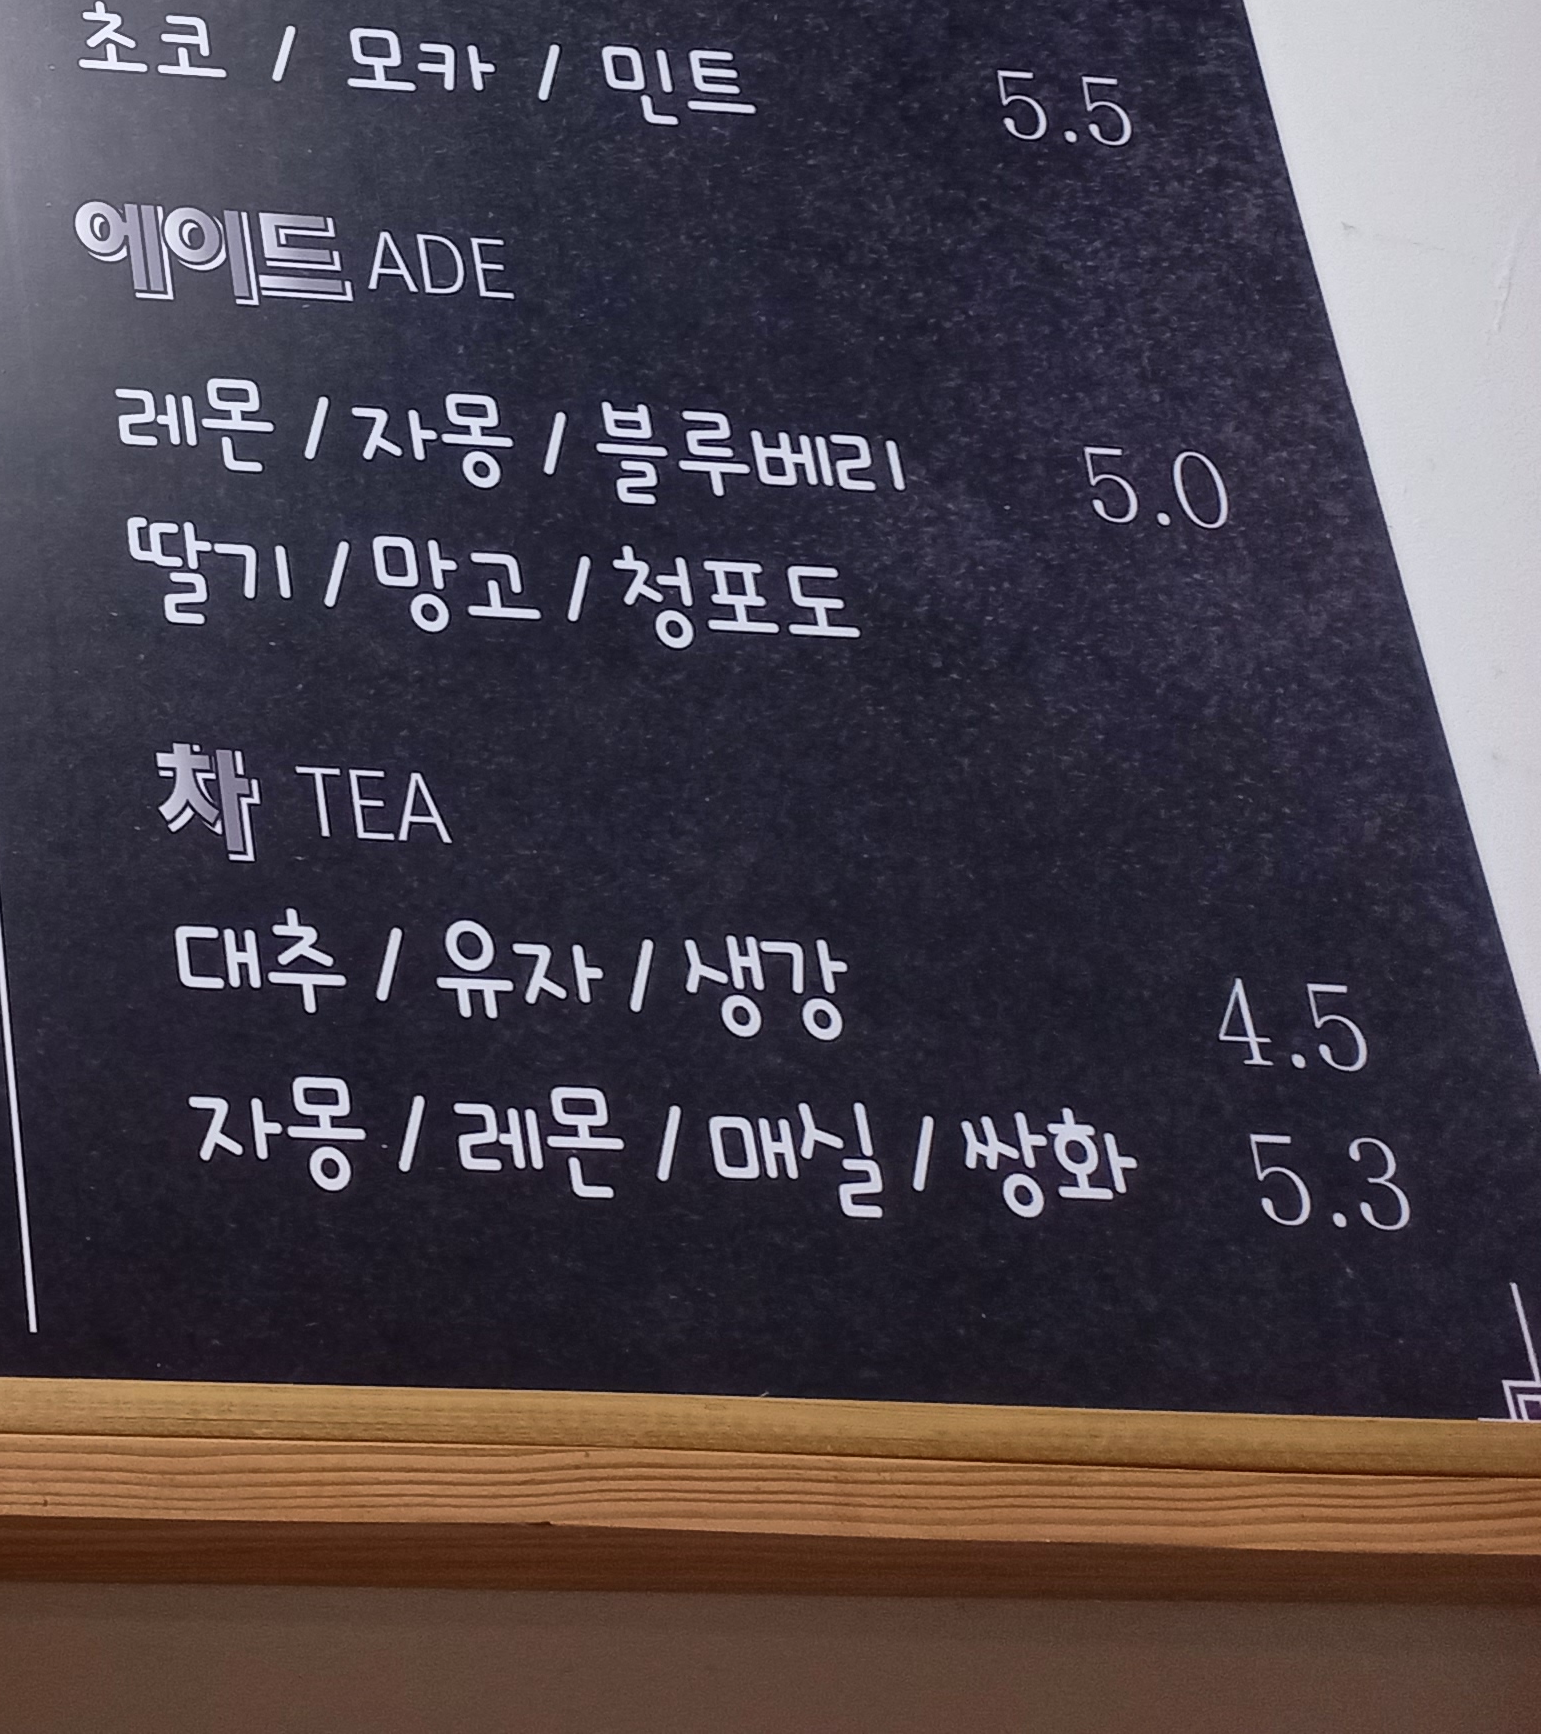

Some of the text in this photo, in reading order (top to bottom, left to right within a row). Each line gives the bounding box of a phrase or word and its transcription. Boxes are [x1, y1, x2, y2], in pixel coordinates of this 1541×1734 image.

[77, 0, 228, 79] 초코
[346, 26, 496, 93] 모카
[600, 44, 757, 126] 민트
[996, 68, 1133, 147] 5.5
[73, 200, 516, 307] 에이드 ADE
[113, 377, 275, 473] 레몬
[350, 392, 514, 490] 자몽
[595, 400, 907, 506] 블루베리
[1082, 445, 1230, 530] 5.0
[125, 515, 292, 626] 딸기
[371, 534, 542, 634] 망고
[611, 544, 862, 650] 청포도
[154, 741, 454, 863] 차 TEA
[173, 907, 348, 1015] 대추
[435, 918, 605, 1020] 유자
[683, 934, 849, 1042] 생강
[1217, 976, 1369, 1073] 4.5
[187, 1075, 368, 1192] 자몽
[452, 1085, 626, 1200] 레몬
[708, 1101, 884, 1220] 매실
[959, 1106, 1139, 1219] 쌍화
[1248, 1132, 1412, 1232] 5.3
